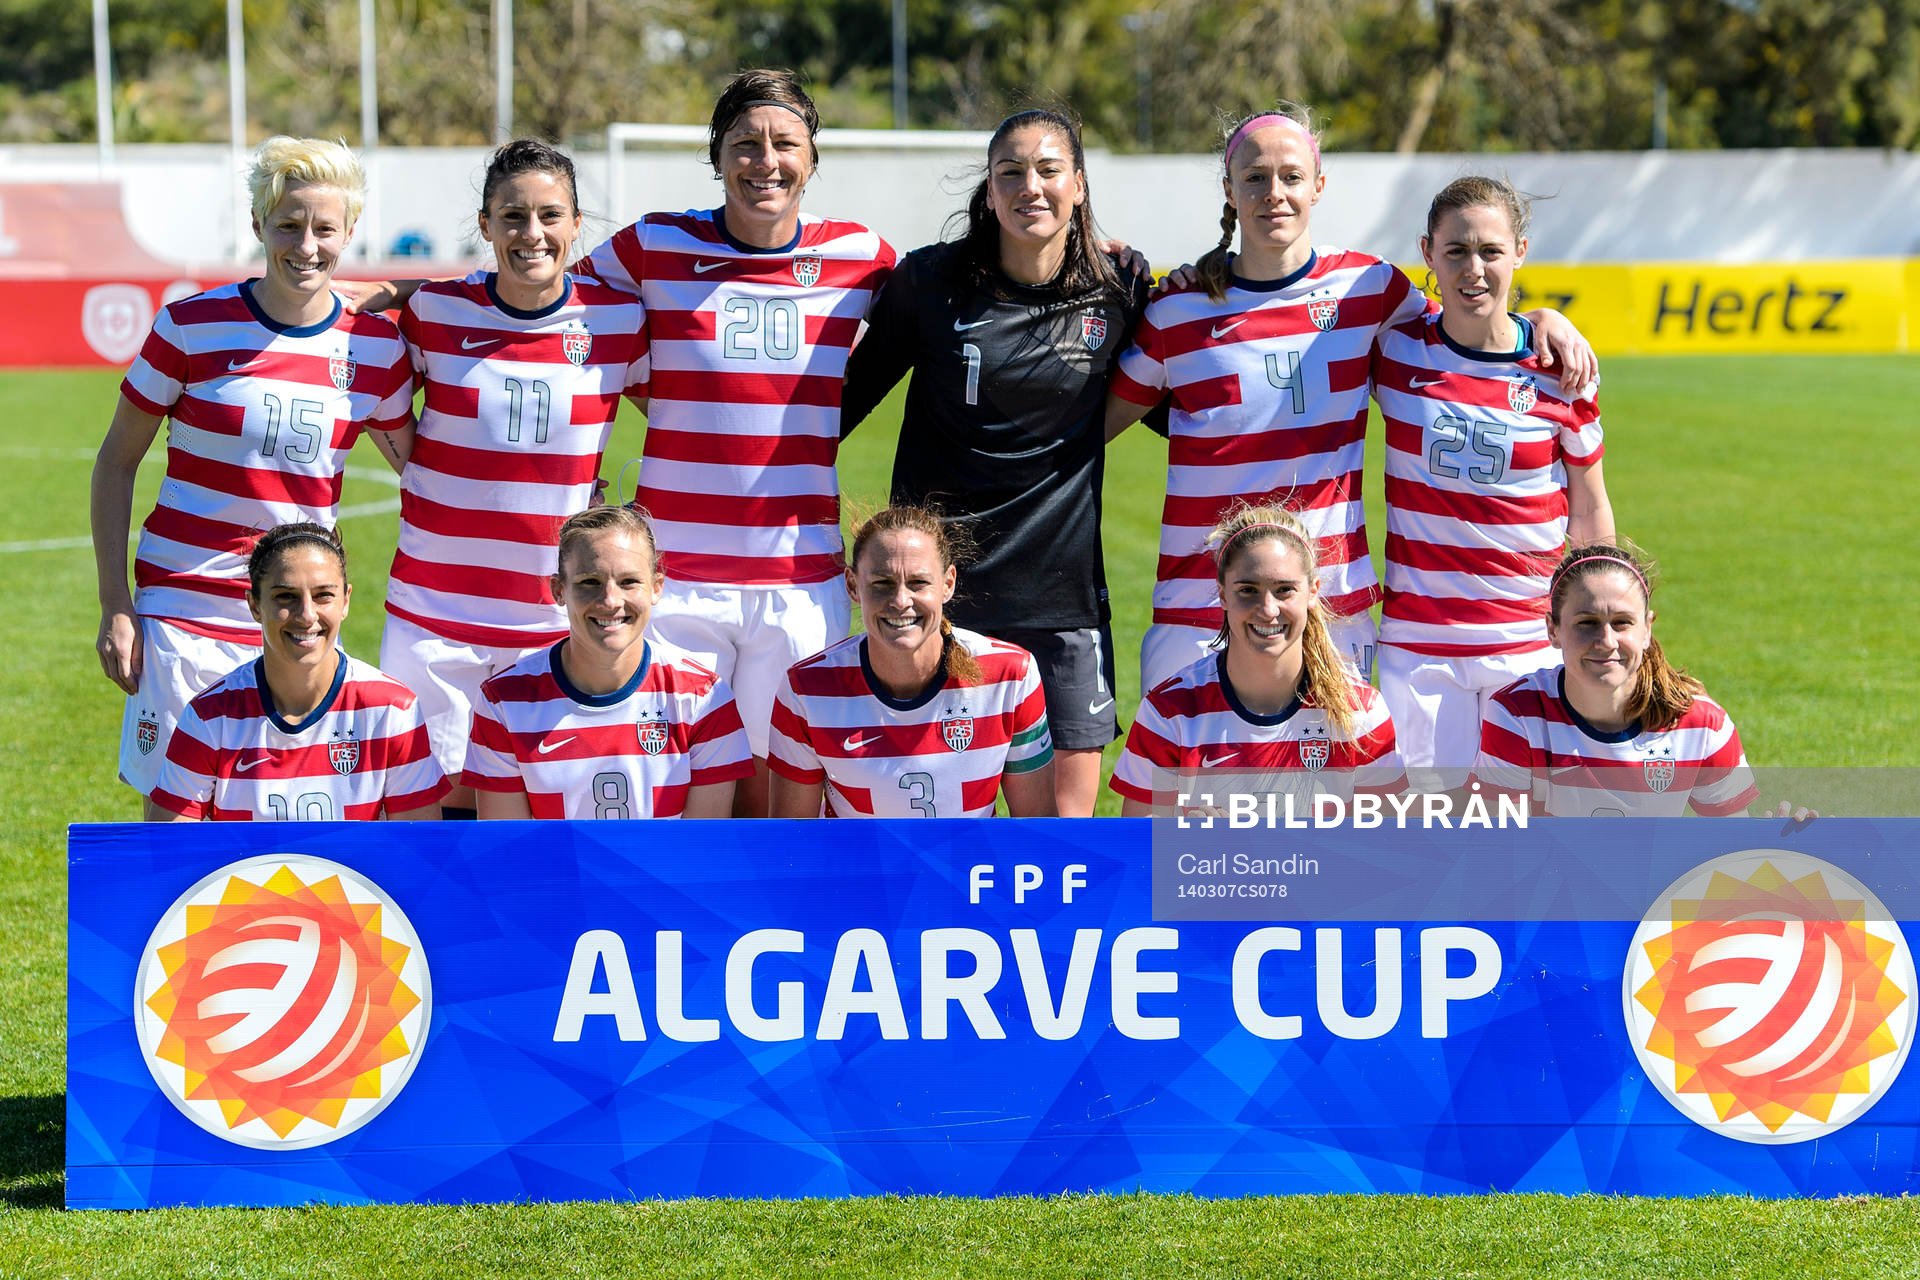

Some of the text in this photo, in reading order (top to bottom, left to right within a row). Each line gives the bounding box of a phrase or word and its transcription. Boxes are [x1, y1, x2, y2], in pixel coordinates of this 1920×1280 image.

[724, 297, 799, 360] 20
[1653, 281, 1846, 334] Hertz
[963, 343, 981, 406] 1
[1264, 351, 1305, 414] 4
[262, 393, 324, 464] 15
[504, 378, 551, 443] 11
[1429, 414, 1508, 484] 25
[592, 771, 630, 820] 8
[898, 771, 937, 818] 3
[552, 926, 1503, 1042] ALGARVE CUP
